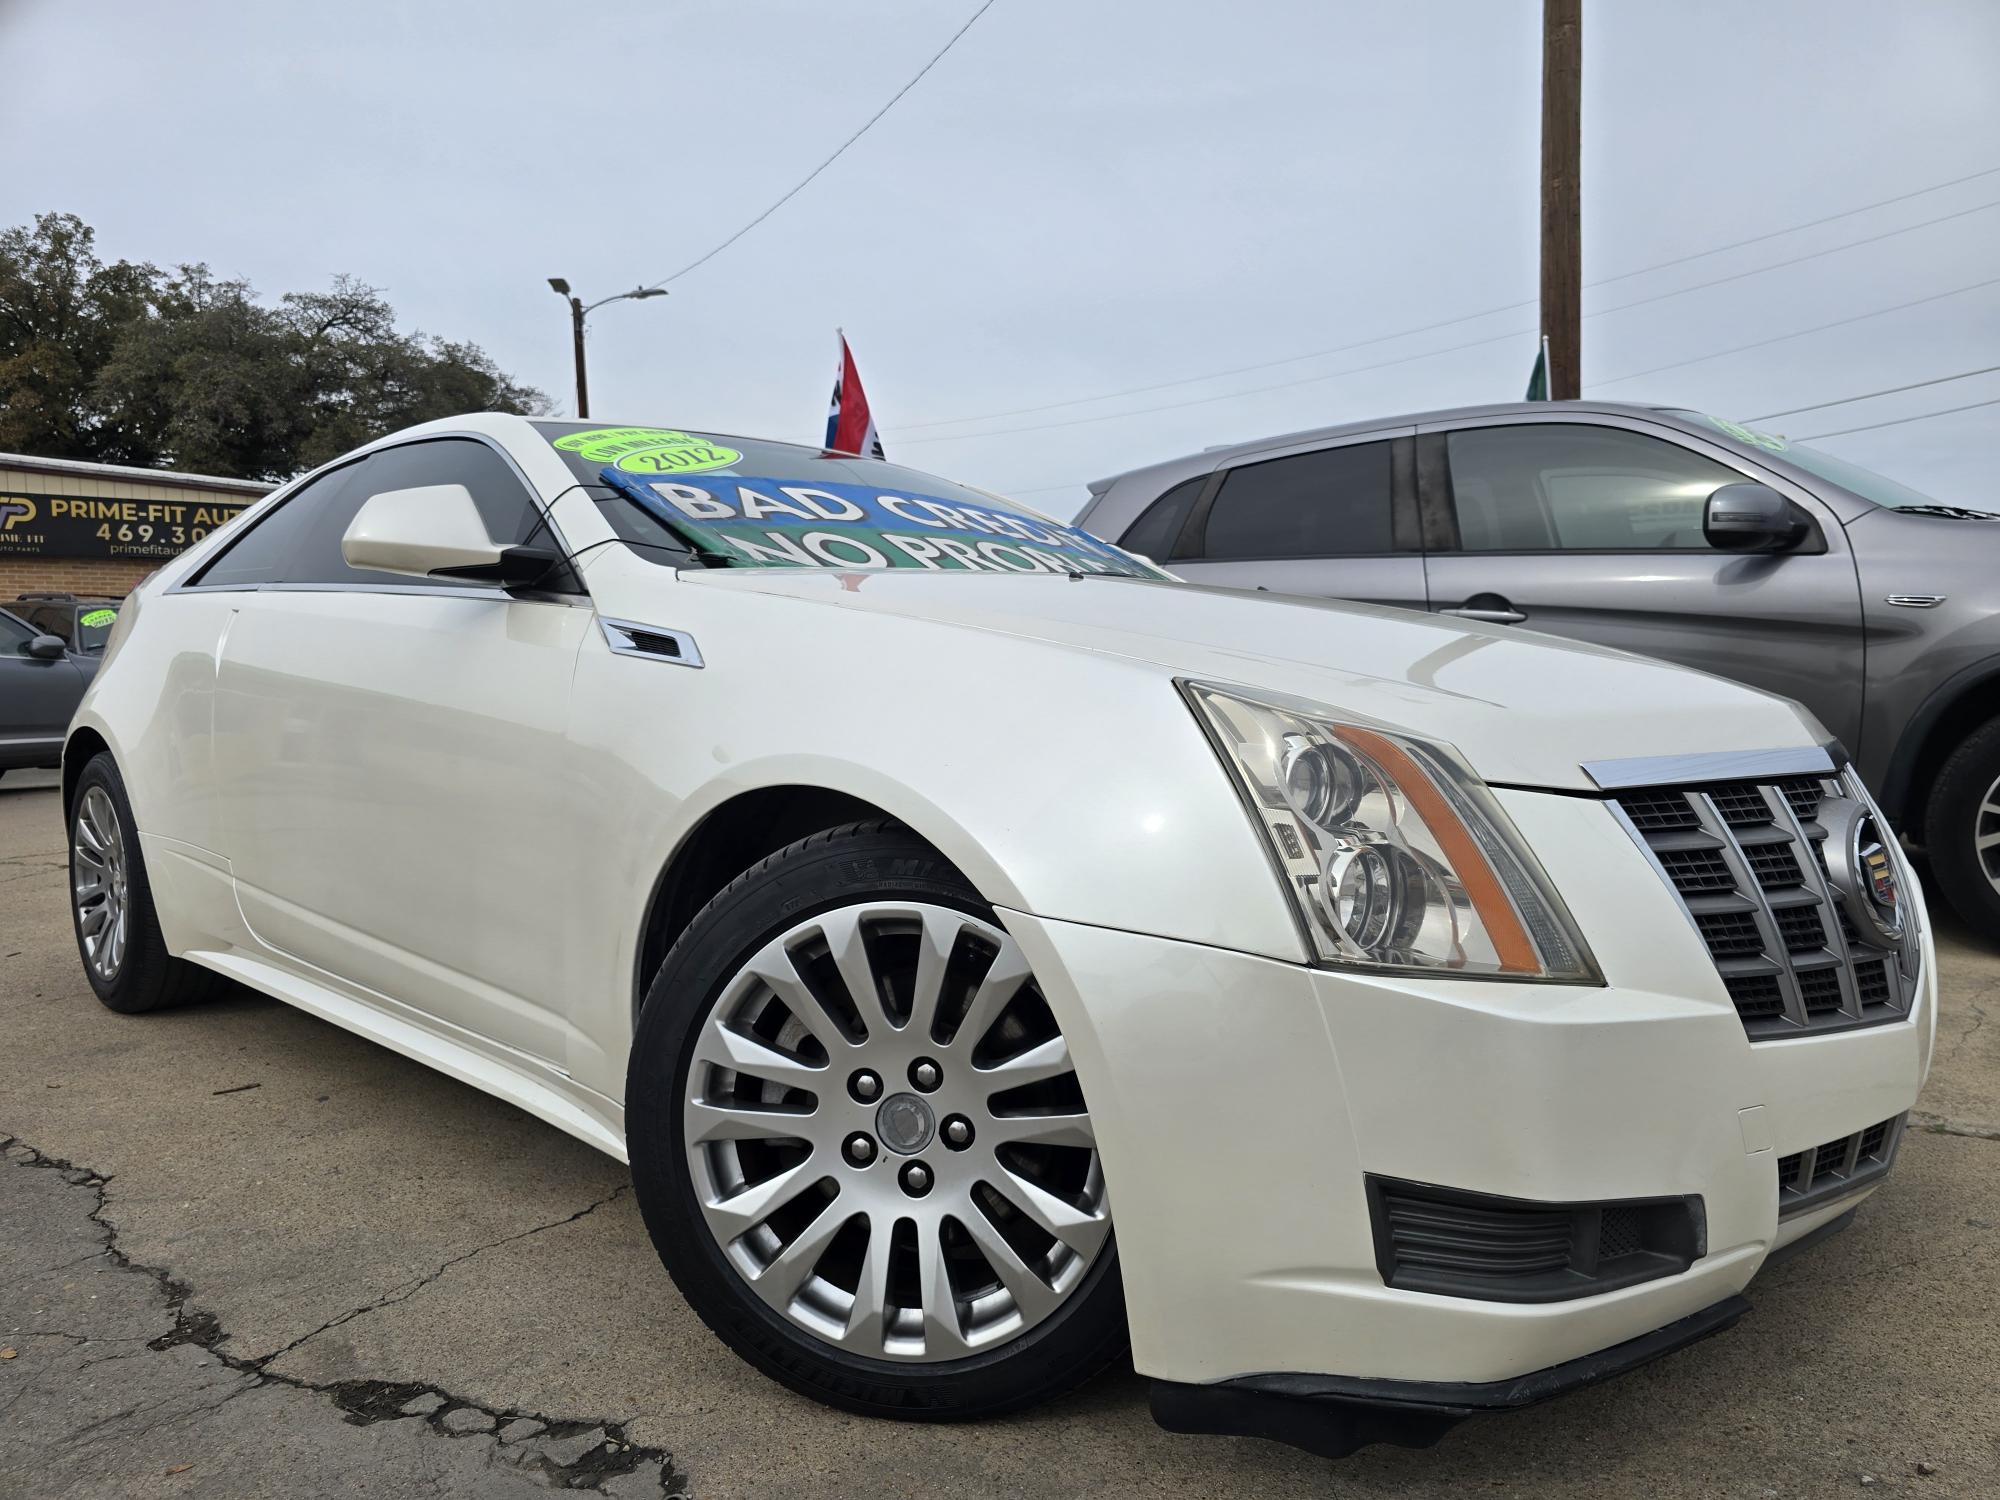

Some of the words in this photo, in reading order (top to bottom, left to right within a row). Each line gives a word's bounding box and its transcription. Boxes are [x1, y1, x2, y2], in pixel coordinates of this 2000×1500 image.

[639, 447, 725, 471] 2012
[51, 499, 186, 524] PRIME-FIT
[648, 482, 863, 521] BAD
[721, 531, 888, 569] NO
